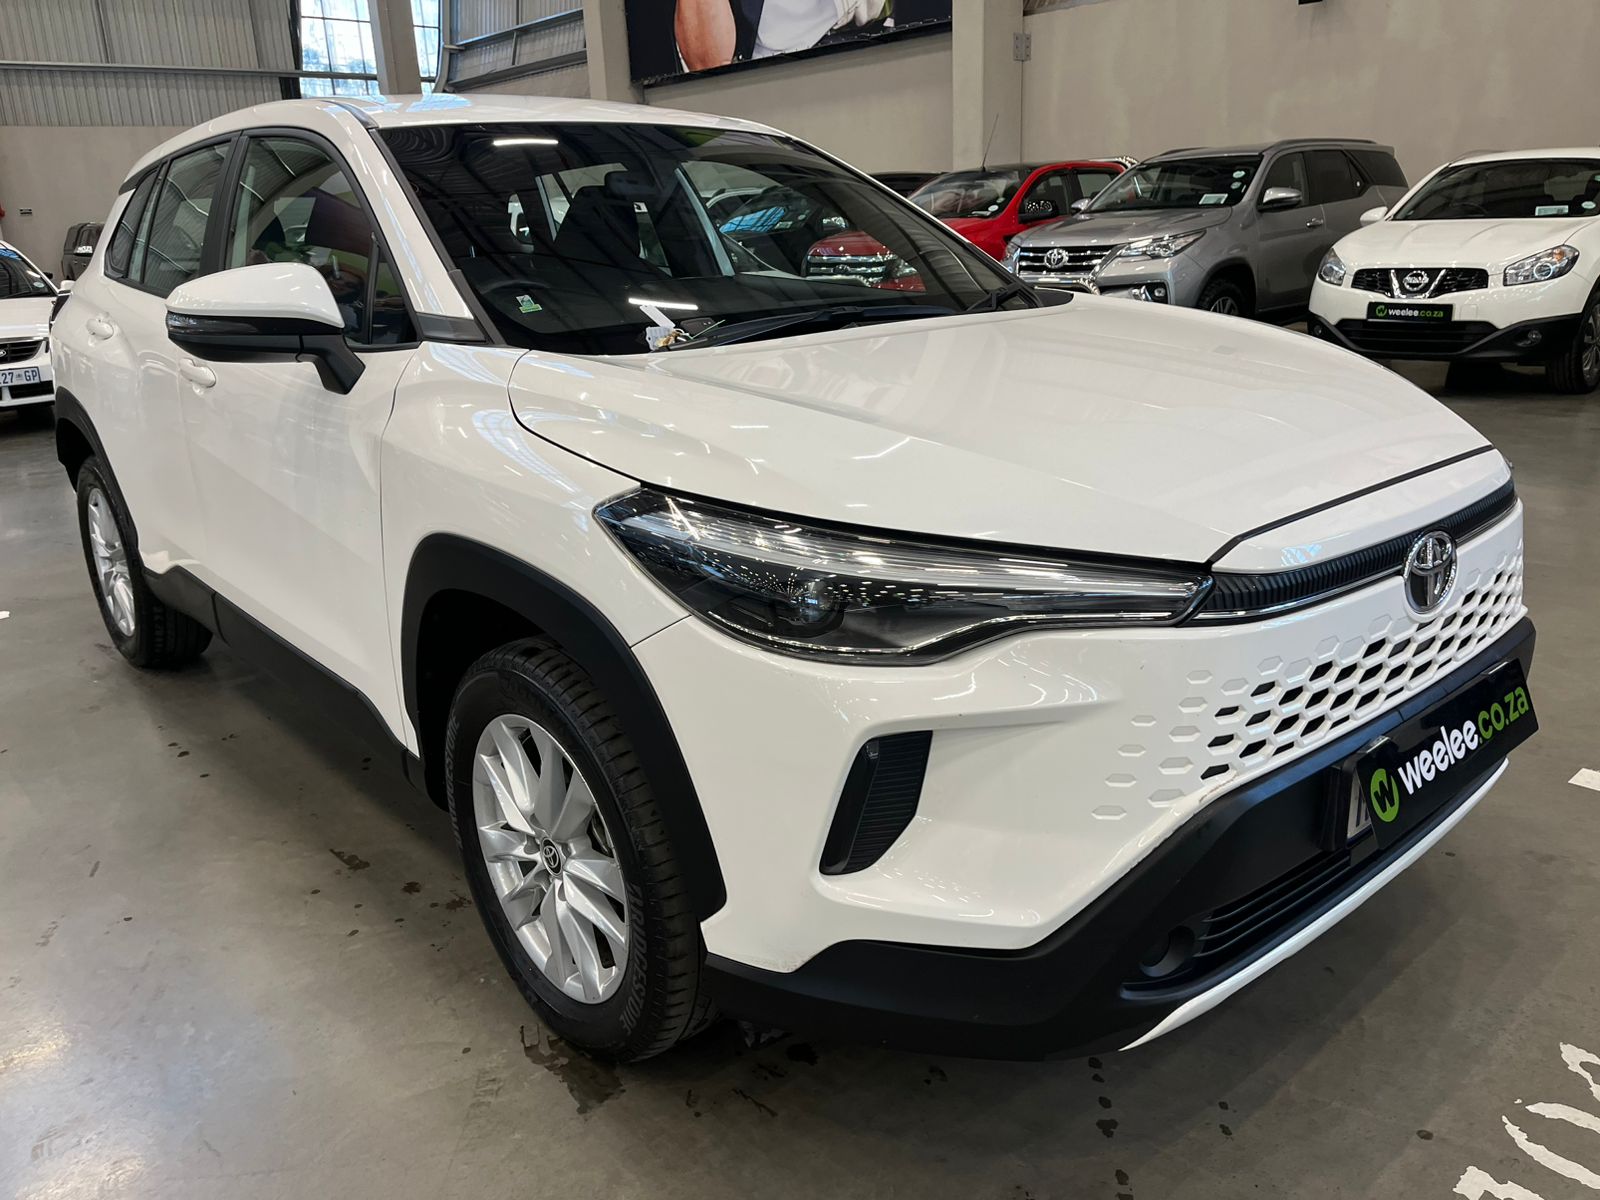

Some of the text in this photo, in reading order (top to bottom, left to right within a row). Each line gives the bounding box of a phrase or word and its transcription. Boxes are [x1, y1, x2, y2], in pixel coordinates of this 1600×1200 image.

[1388, 308, 1444, 317] weelee.co.za
[0, 370, 37, 385] 27 GP
[1398, 686, 1530, 795] weelee.co.za
